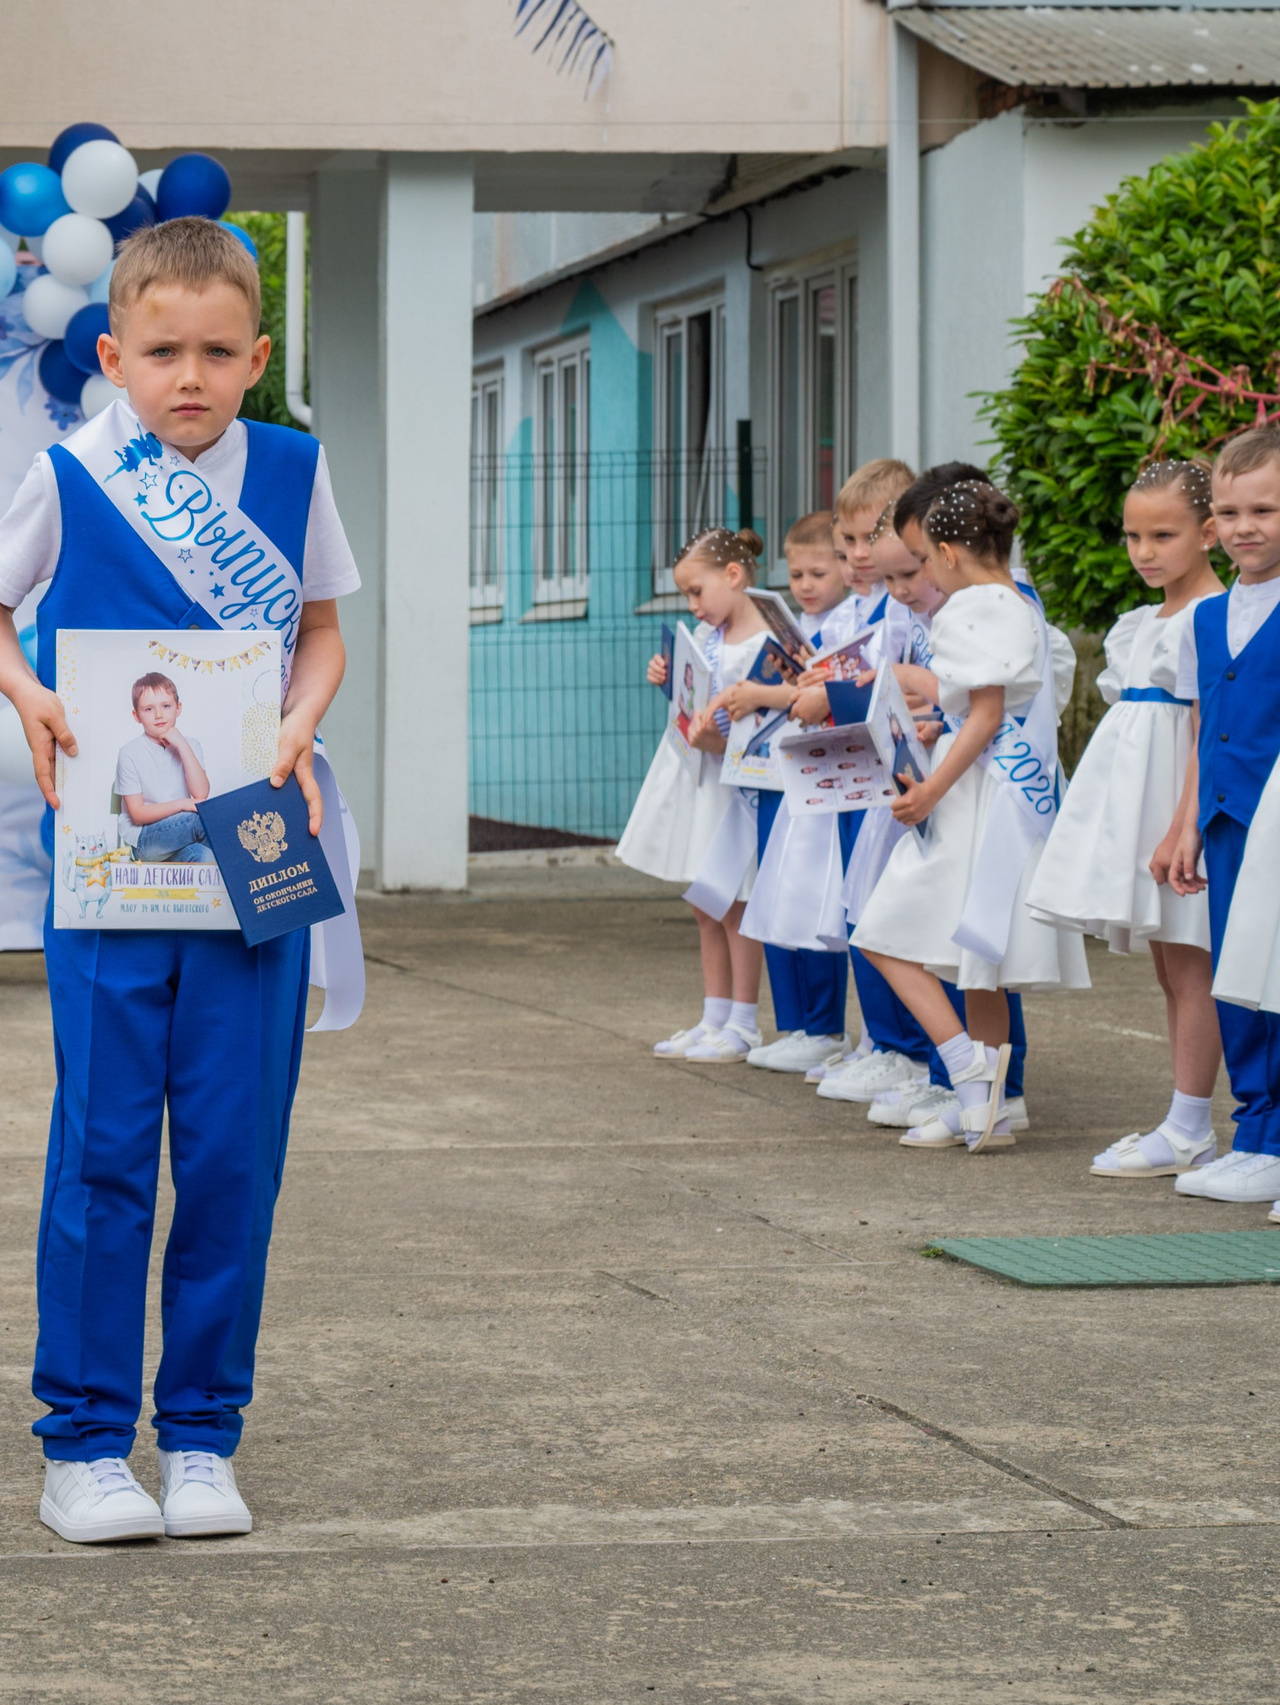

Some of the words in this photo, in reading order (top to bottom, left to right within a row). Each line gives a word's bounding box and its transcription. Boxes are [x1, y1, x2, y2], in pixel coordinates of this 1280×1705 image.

[993, 742, 1054, 815] 2026
[115, 867, 139, 886] НАШ
[144, 866, 194, 886] ДЕТСКИЙ
[198, 868, 221, 887] САД
[248, 861, 310, 894] ДИПЛОМ
[253, 896, 265, 905] ОБ
[265, 878, 314, 901] ОКОНЧАНИИ
[256, 893, 297, 914] ДЕТСКОГО
[297, 886, 318, 898] САДА
[173, 904, 210, 914] ВЫГОТСКОГО
